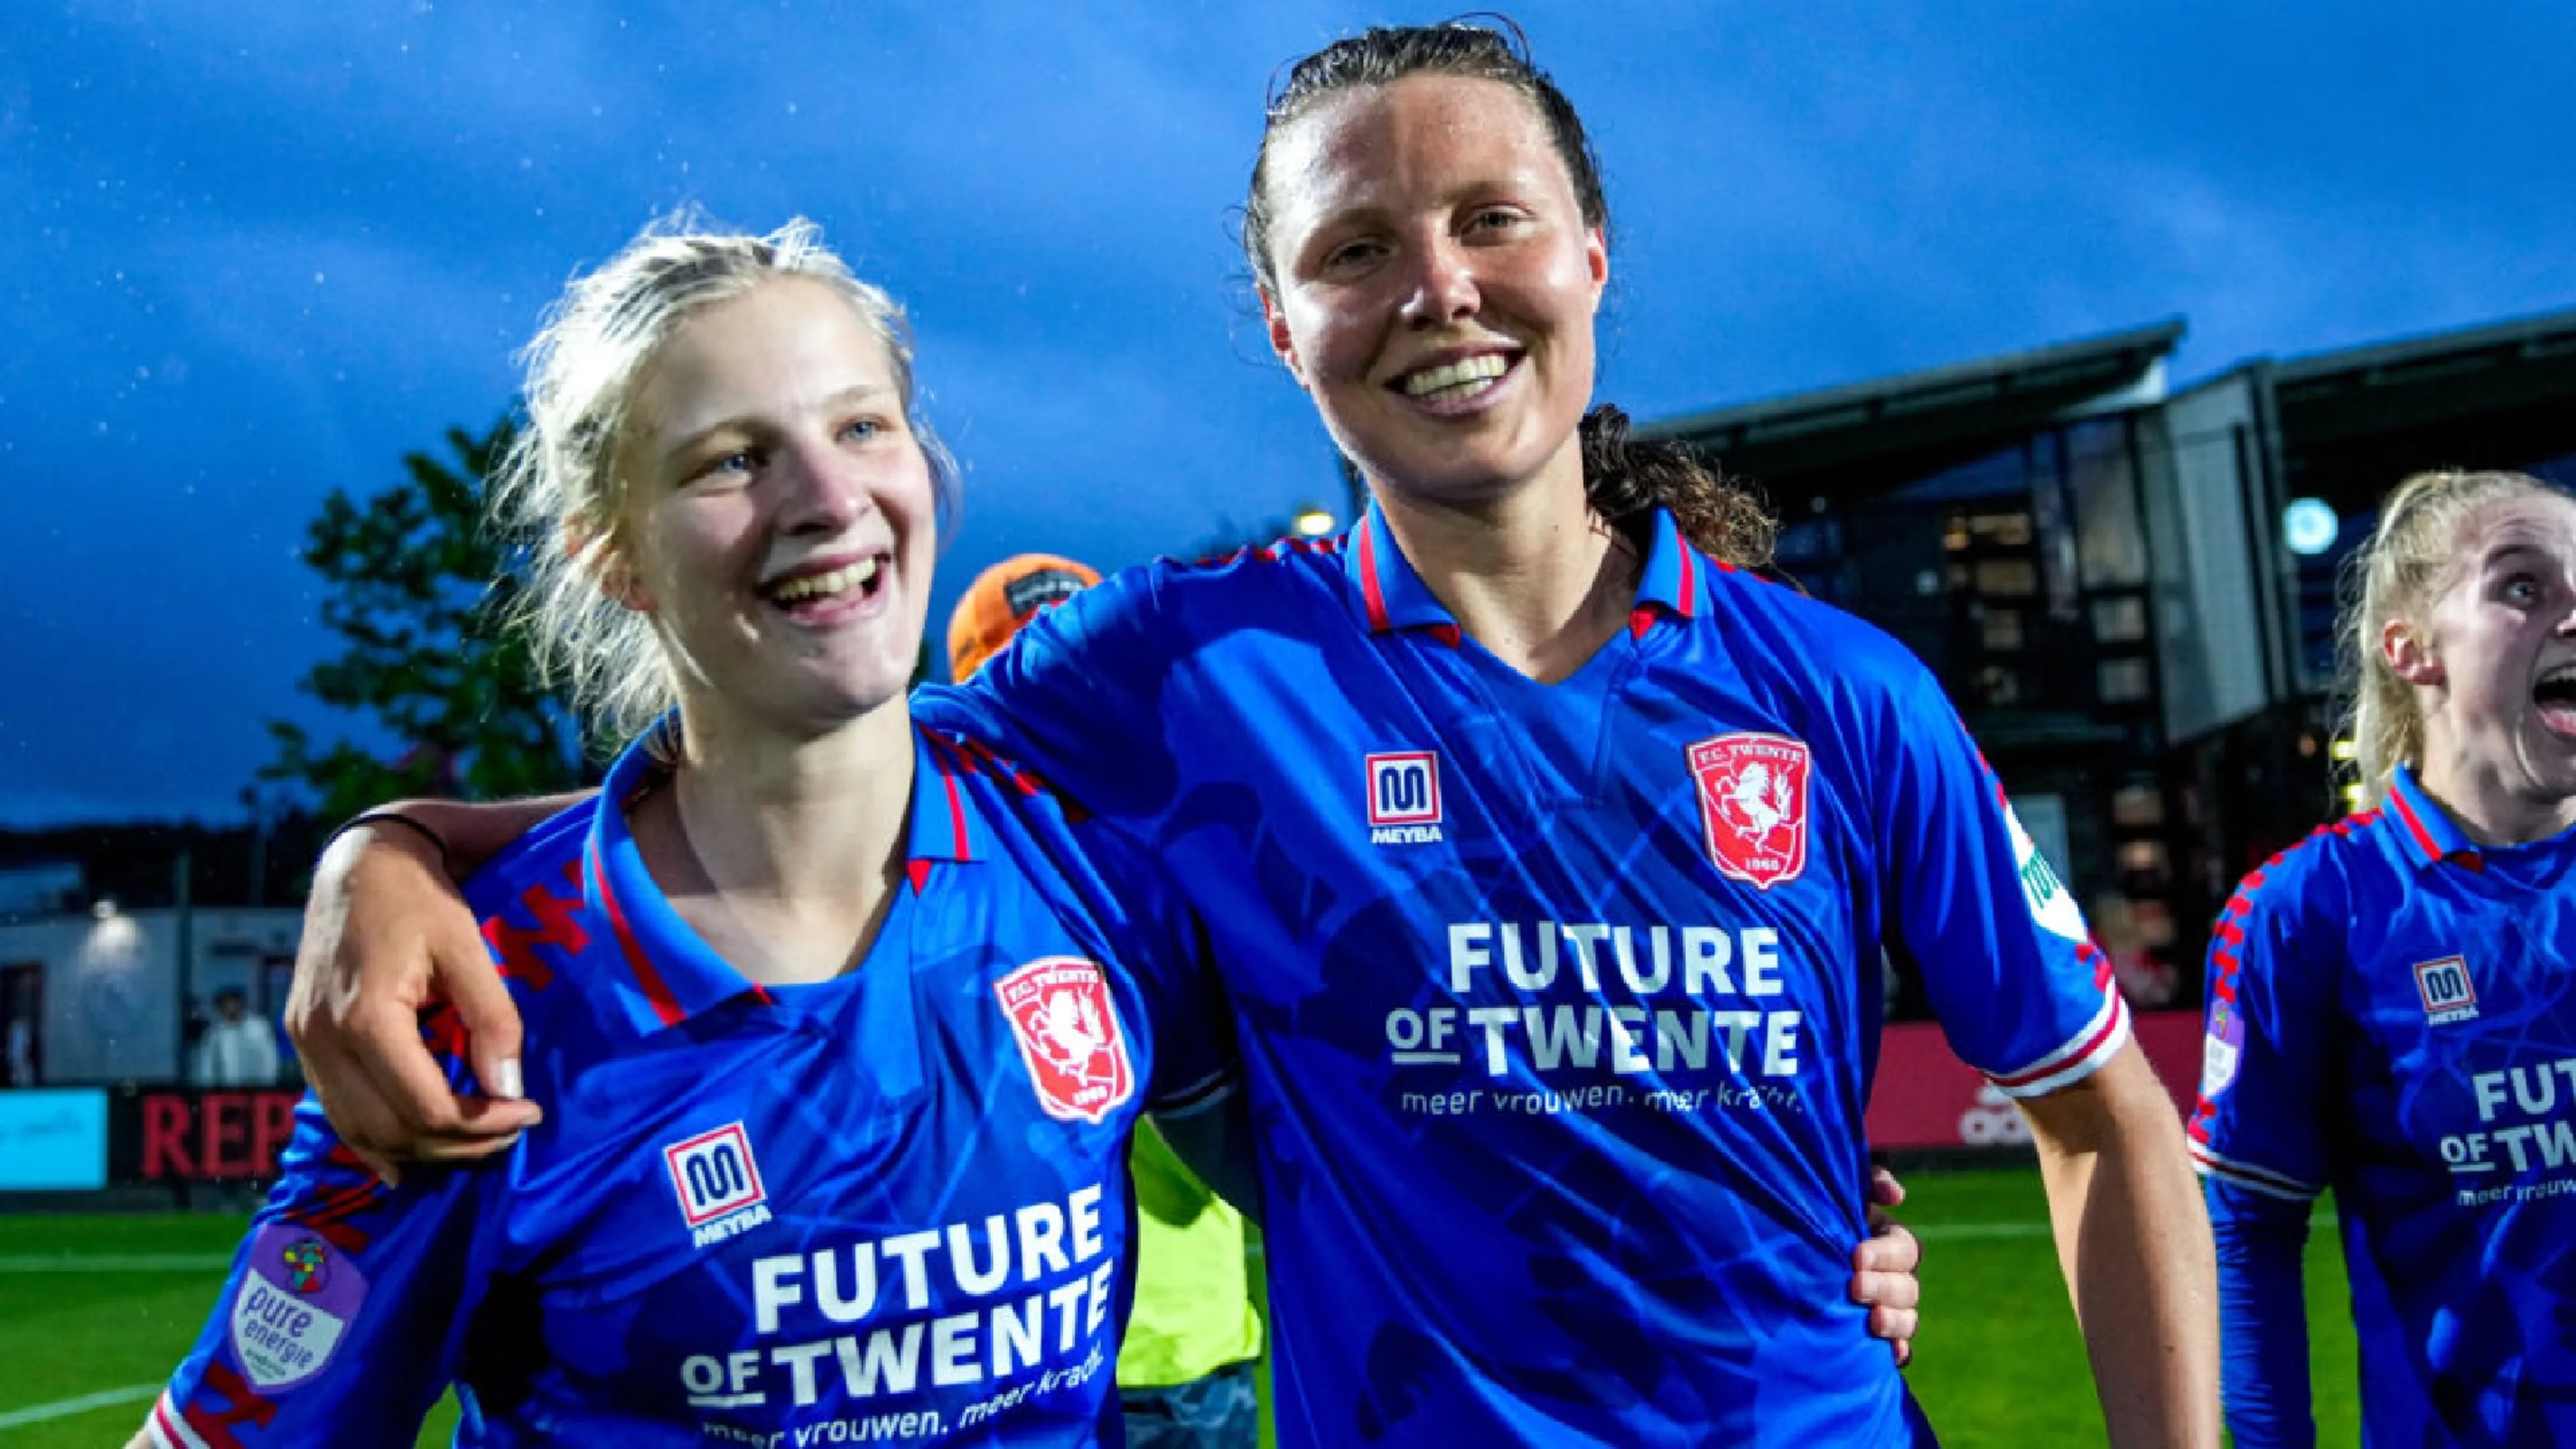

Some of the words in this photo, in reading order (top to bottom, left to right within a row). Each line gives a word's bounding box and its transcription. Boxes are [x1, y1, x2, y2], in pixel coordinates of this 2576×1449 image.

[1371, 824, 1443, 845] MEYBA
[1448, 920, 1784, 997] FUTURE
[1385, 1008, 1456, 1051] OF
[1467, 1004, 1803, 1077] TWENTE
[1401, 1089, 1483, 1115] meer
[2440, 1134, 2489, 1163] OF
[694, 1204, 773, 1250] MEYBA
[751, 1183, 1102, 1335] FUTURE
[242, 1285, 313, 1338] pure
[680, 1352, 763, 1396] OF
[770, 1259, 1114, 1407] TWENTE
[244, 1318, 314, 1369] energie
[793, 1410, 949, 1448] vrouwen.
[957, 1380, 1036, 1430] meer
